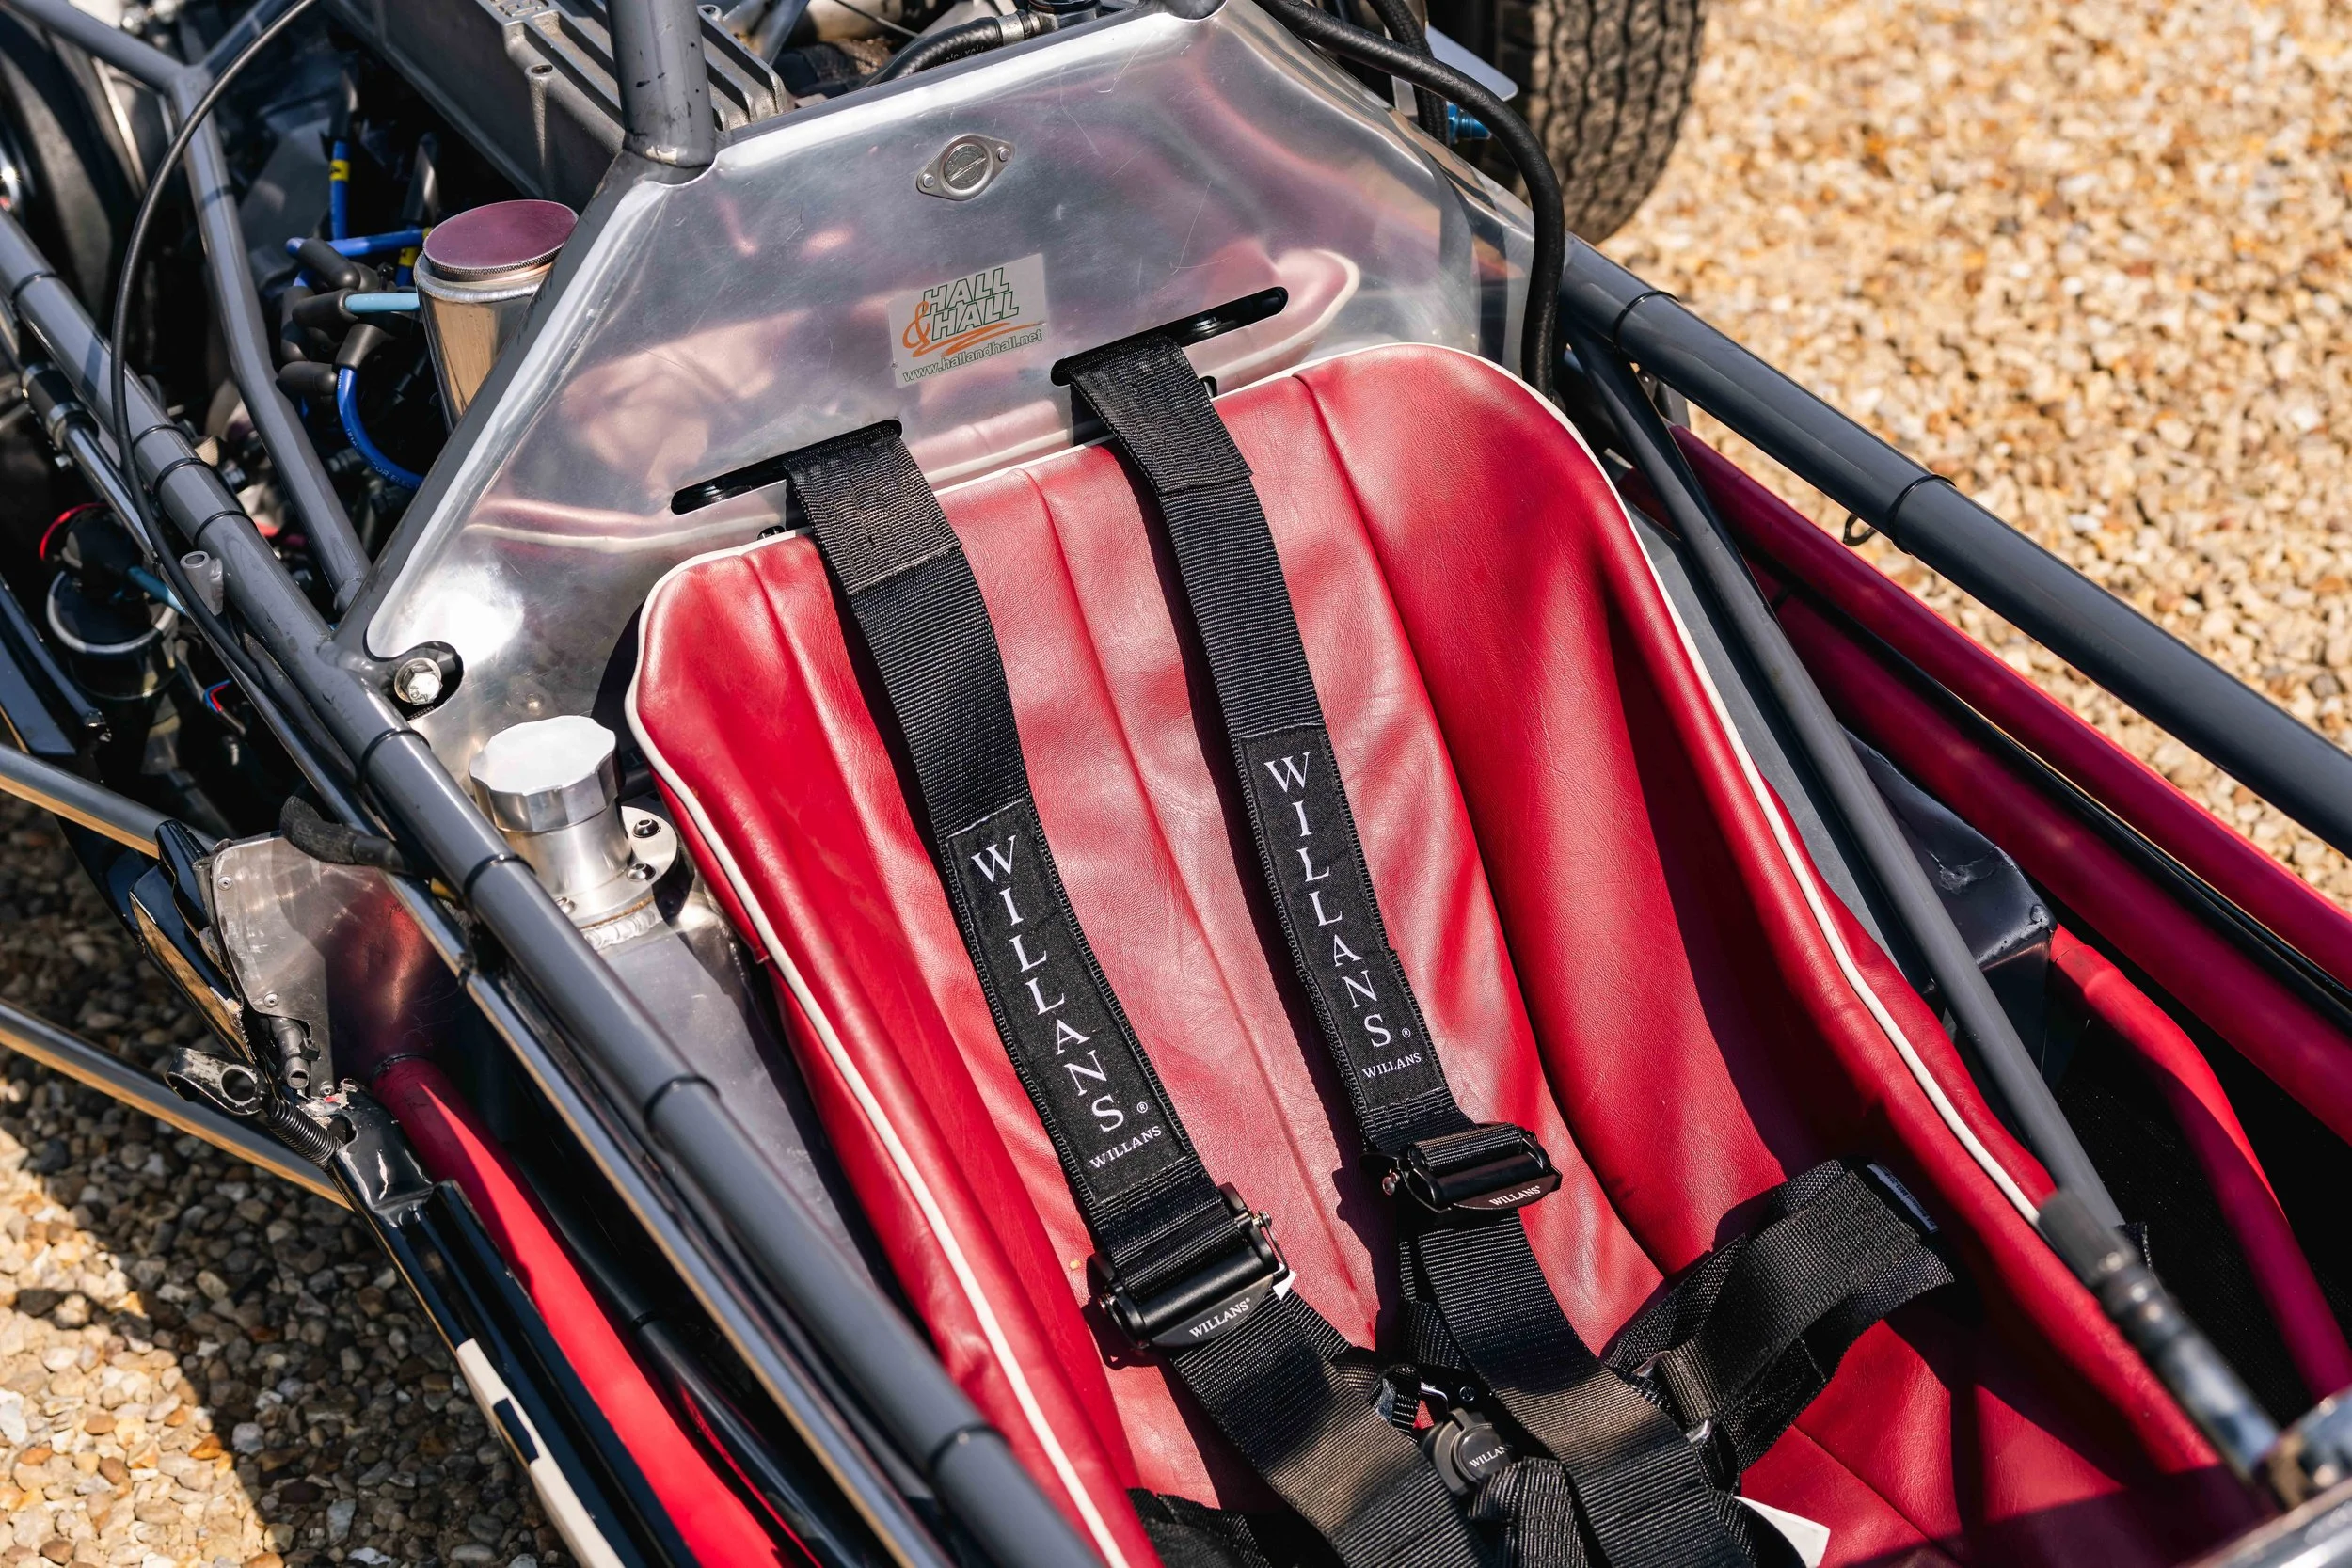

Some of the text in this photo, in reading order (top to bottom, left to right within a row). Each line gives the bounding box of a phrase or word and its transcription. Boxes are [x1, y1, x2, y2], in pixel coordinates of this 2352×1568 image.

[921, 267, 1009, 316] HALL
[902, 291, 1019, 348] & HALL
[903, 329, 1042, 382] www.hallandhall.net
[1361, 1053, 1422, 1078] WILLANS
[1089, 1126, 1162, 1169] WILLANS
